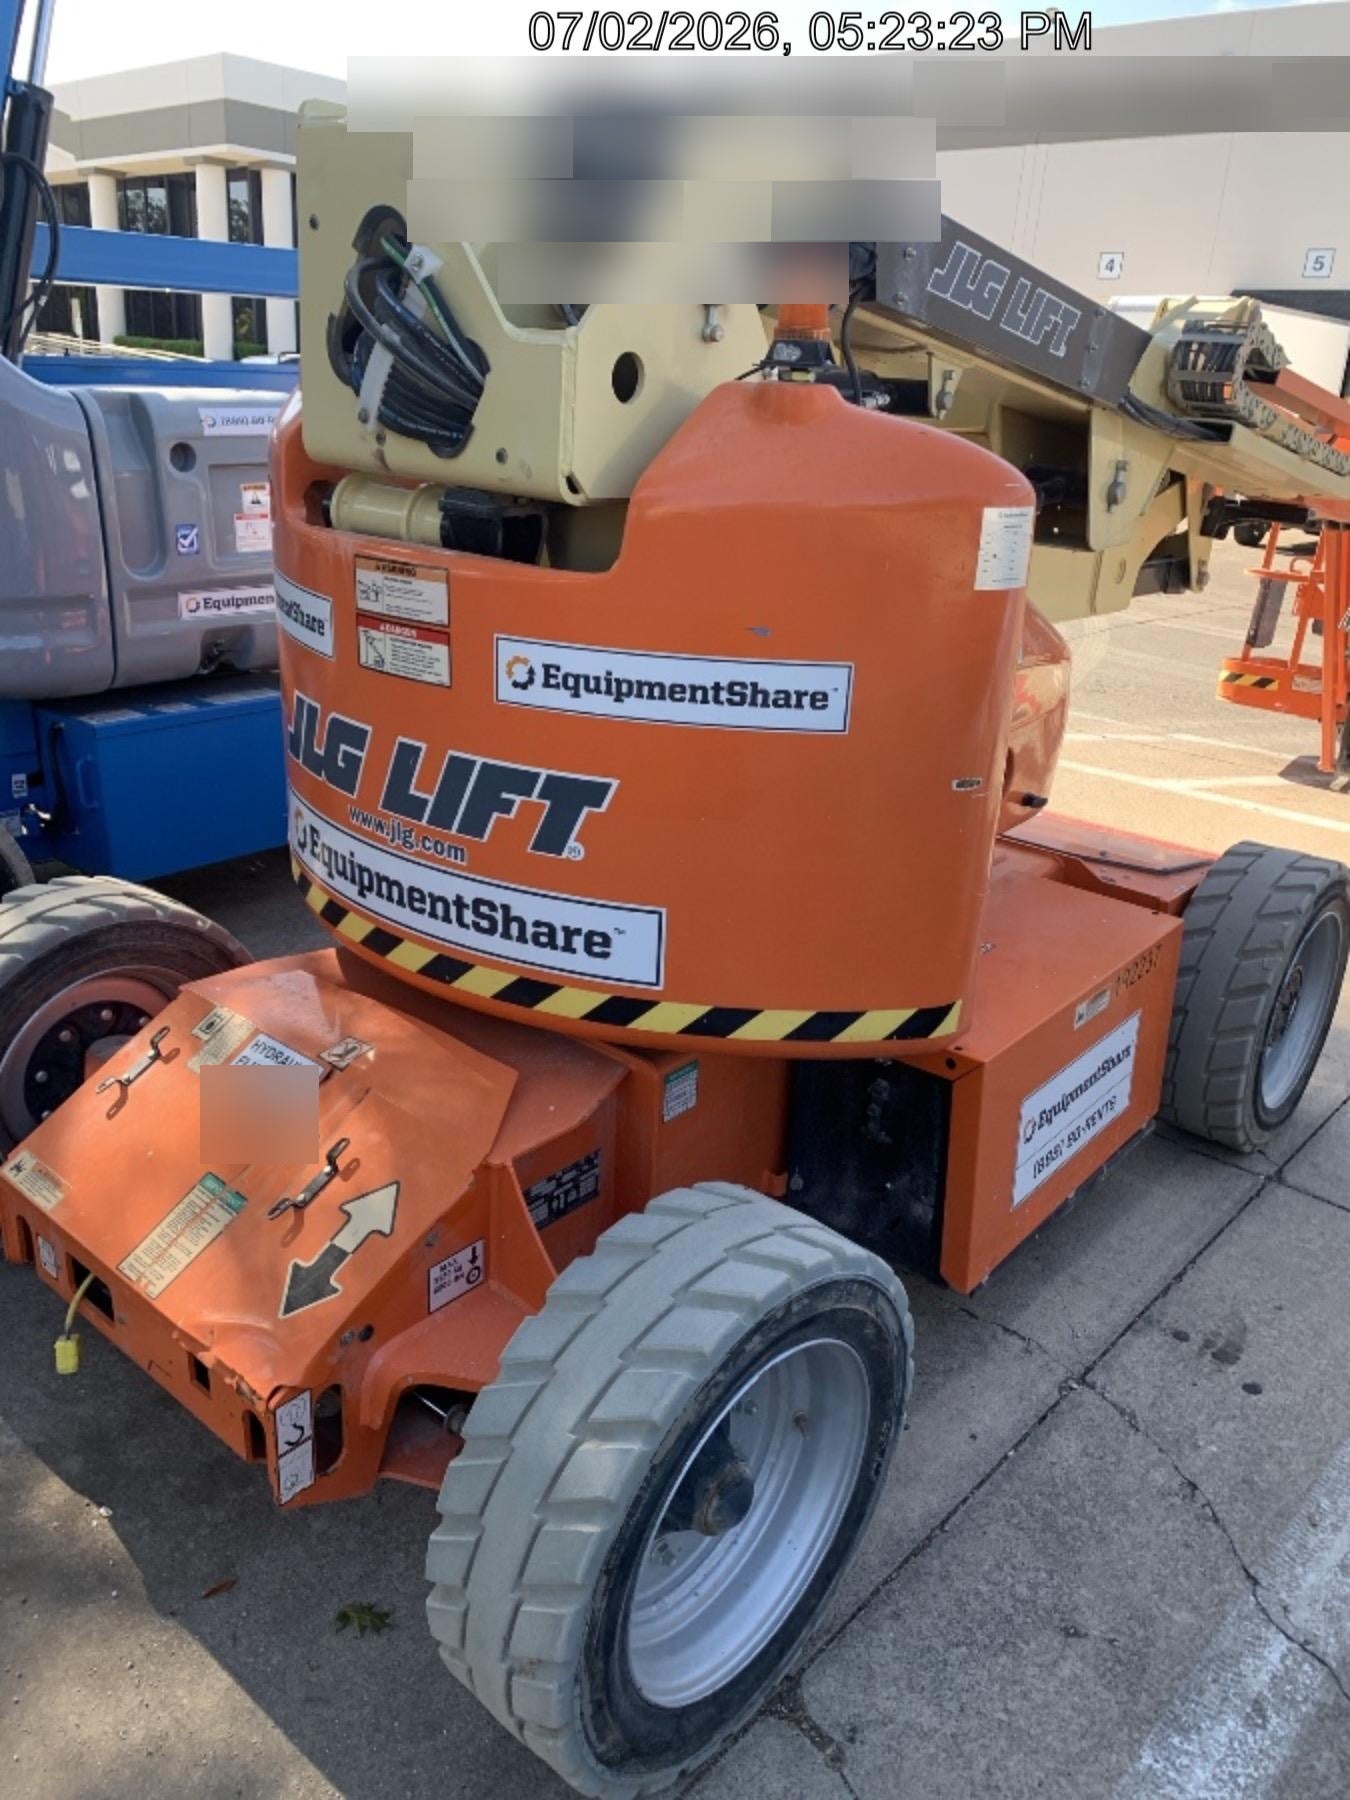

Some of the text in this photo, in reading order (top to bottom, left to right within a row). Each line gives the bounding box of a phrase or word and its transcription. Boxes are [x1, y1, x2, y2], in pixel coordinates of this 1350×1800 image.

[1104, 257, 1116, 273] 4
[1312, 254, 1326, 272] 5
[926, 240, 1082, 357] JLG LIFT
[541, 661, 829, 712] EquipmentShare
[287, 689, 621, 858] JLG LIFT
[347, 803, 467, 866] www.jlg.com
[308, 823, 614, 960] EquipmentShare
